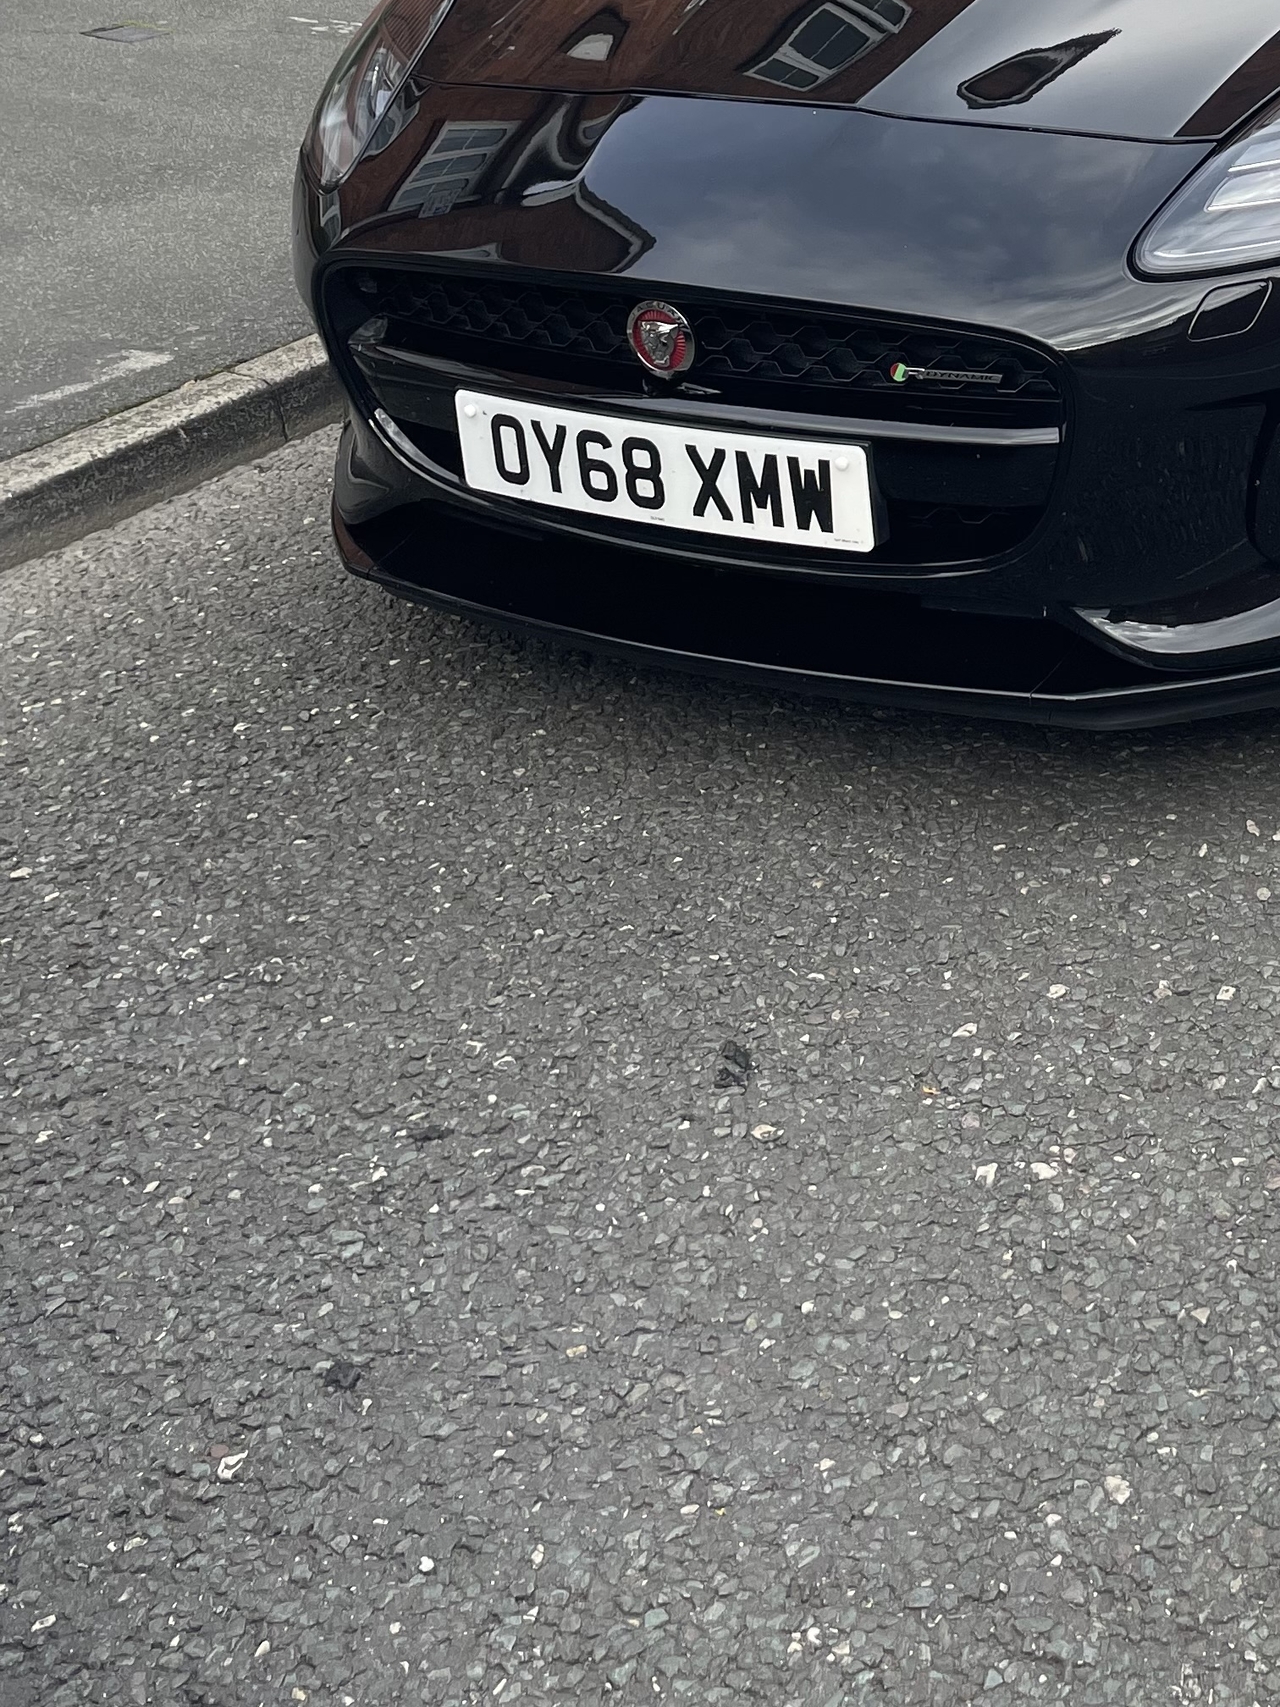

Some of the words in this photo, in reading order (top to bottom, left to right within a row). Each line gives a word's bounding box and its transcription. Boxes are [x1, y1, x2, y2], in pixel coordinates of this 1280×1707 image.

[926, 371, 1000, 382] DYNAMIC
[491, 413, 666, 511] OY68
[685, 443, 834, 534] XMW
